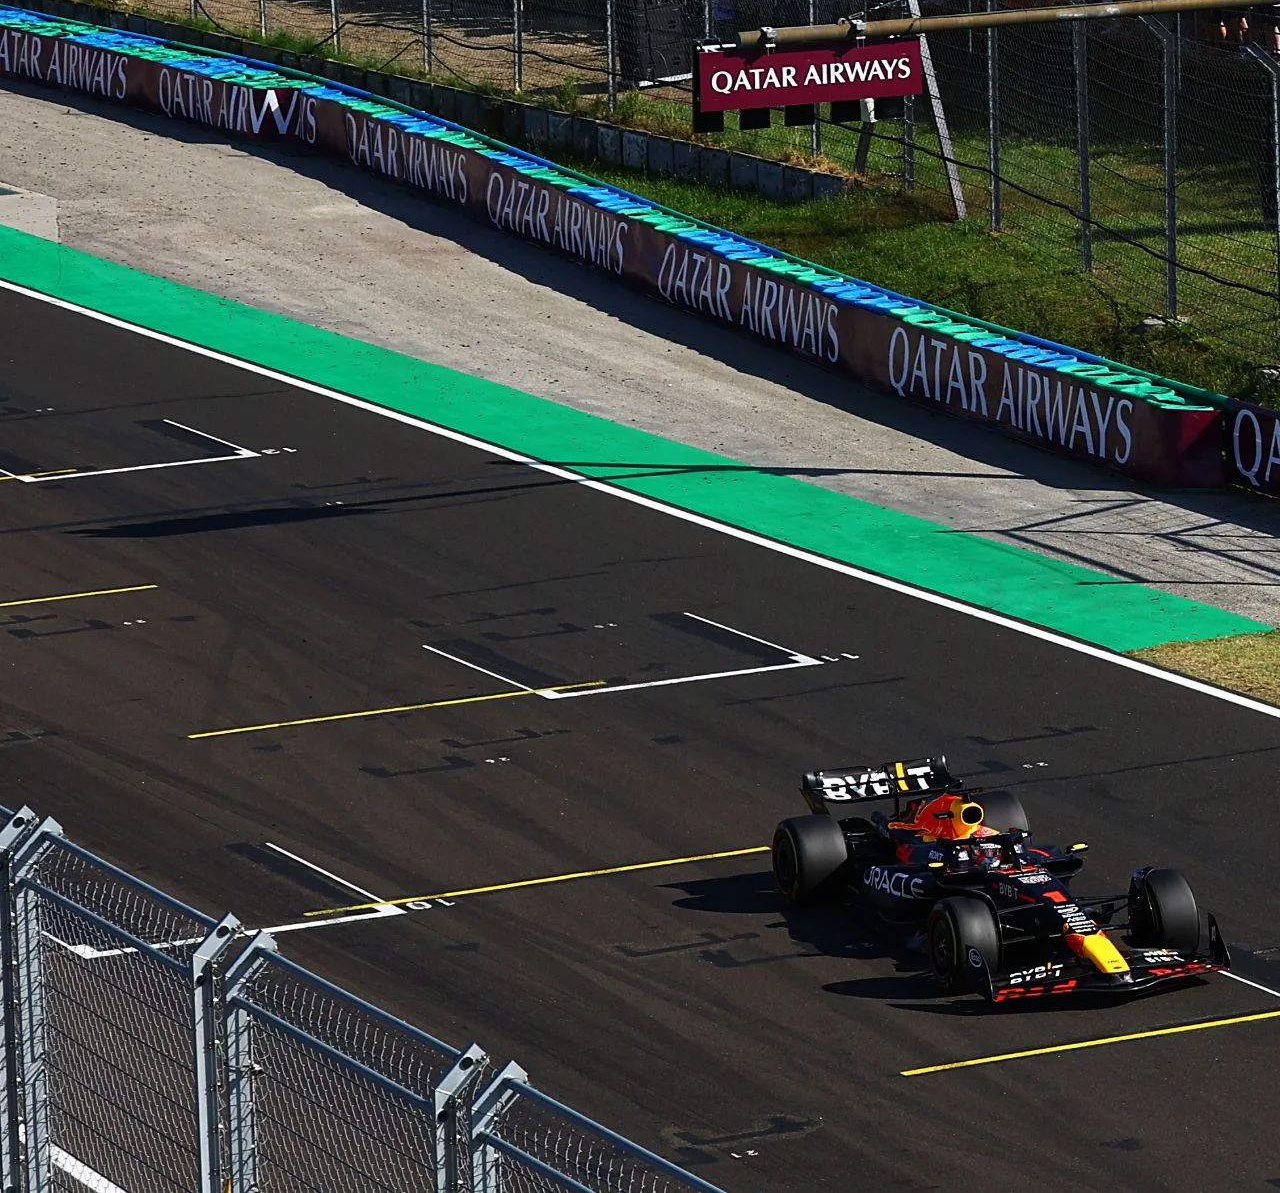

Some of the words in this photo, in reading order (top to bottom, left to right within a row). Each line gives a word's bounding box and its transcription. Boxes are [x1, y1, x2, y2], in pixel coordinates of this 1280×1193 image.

[47, 40, 128, 99] AIRWAYS
[159, 68, 213, 126] QATAR
[711, 67, 798, 94] QATAR
[803, 58, 911, 86] AIRWAYS
[486, 172, 551, 244] QATAR
[658, 243, 733, 323] QATAR
[741, 274, 839, 363] AIRWAYS
[888, 326, 989, 418] QATAR
[997, 365, 1134, 465] AIRWAYS
